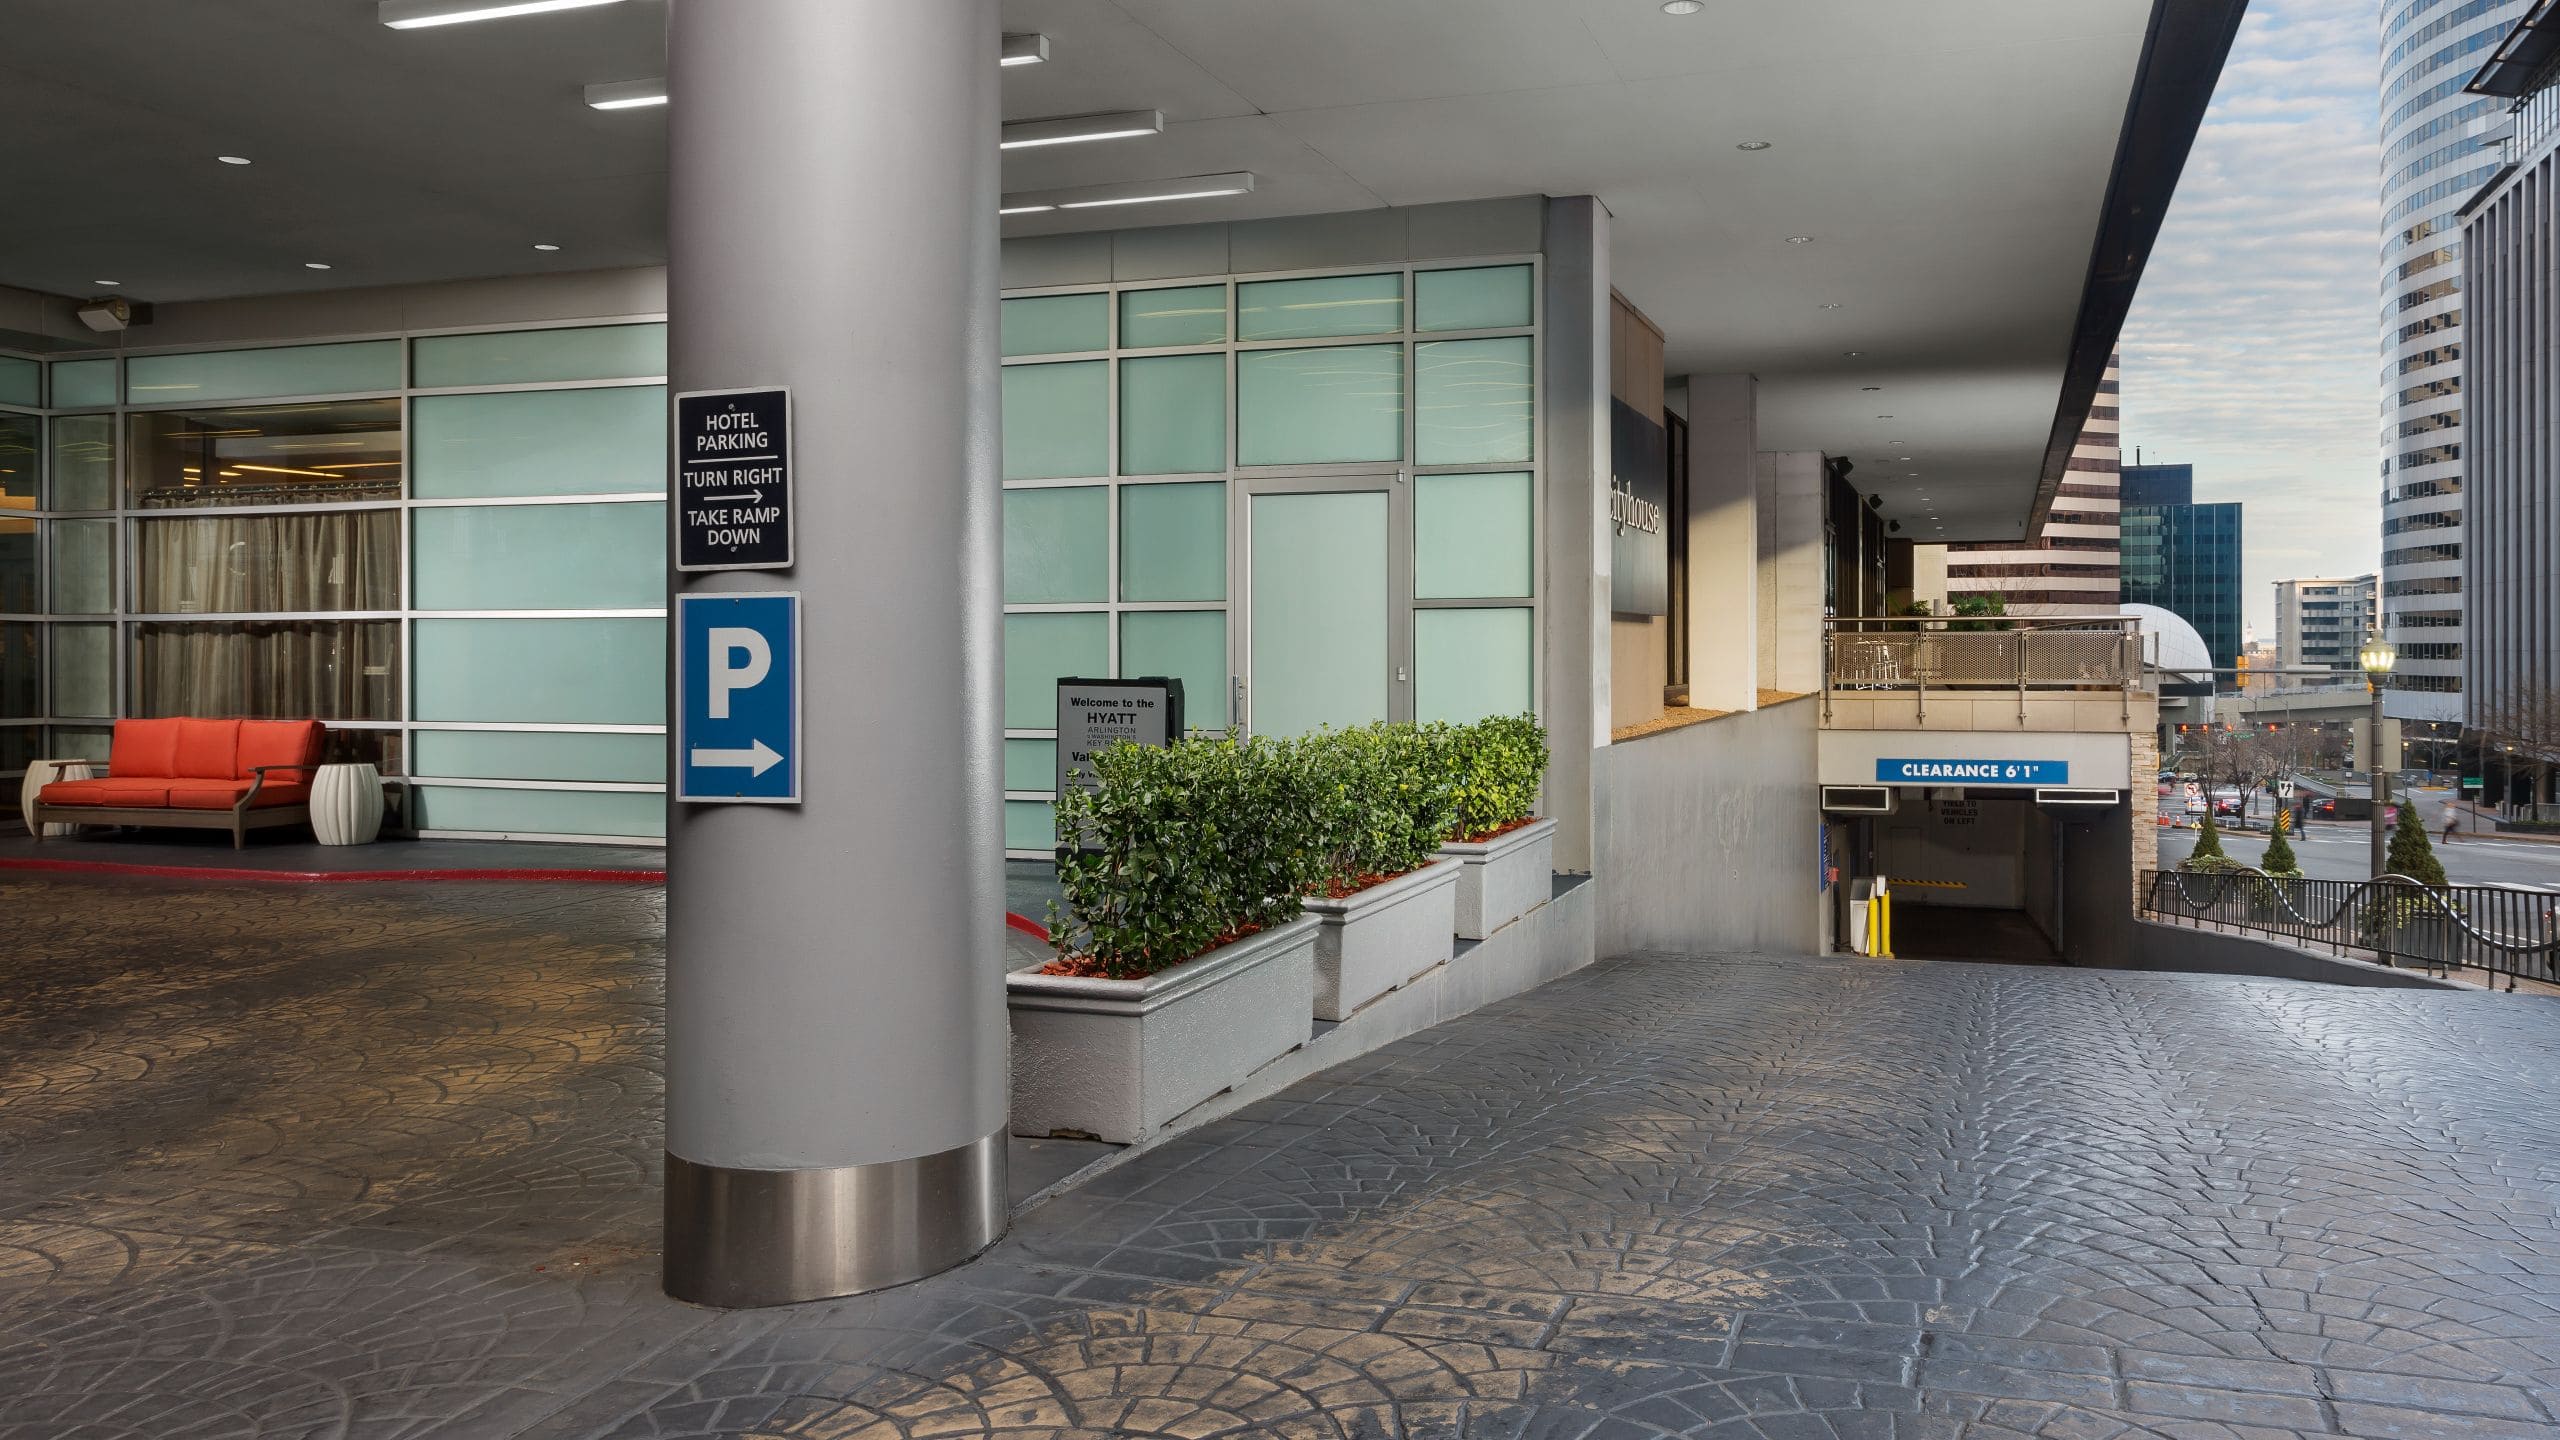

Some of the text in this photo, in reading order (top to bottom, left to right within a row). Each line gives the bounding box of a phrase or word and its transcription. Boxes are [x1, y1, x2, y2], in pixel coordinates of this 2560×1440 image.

[706, 412, 759, 431] HOTEL
[697, 432, 768, 452] PARKING
[683, 467, 783, 488] TURN RIGHT
[687, 507, 780, 526] TAKE RAMP
[707, 528, 760, 546] DOWN
[708, 627, 772, 719] P
[1071, 697, 1154, 708] Welcome to the
[1087, 712, 1137, 725] HYATT
[1087, 726, 1136, 734] ARLINGTON
[1902, 763, 2039, 778] CLEARANCE 6'1"
[1941, 808, 1978, 816] VEHICLES
[1943, 817, 1976, 825] ON LEFT
